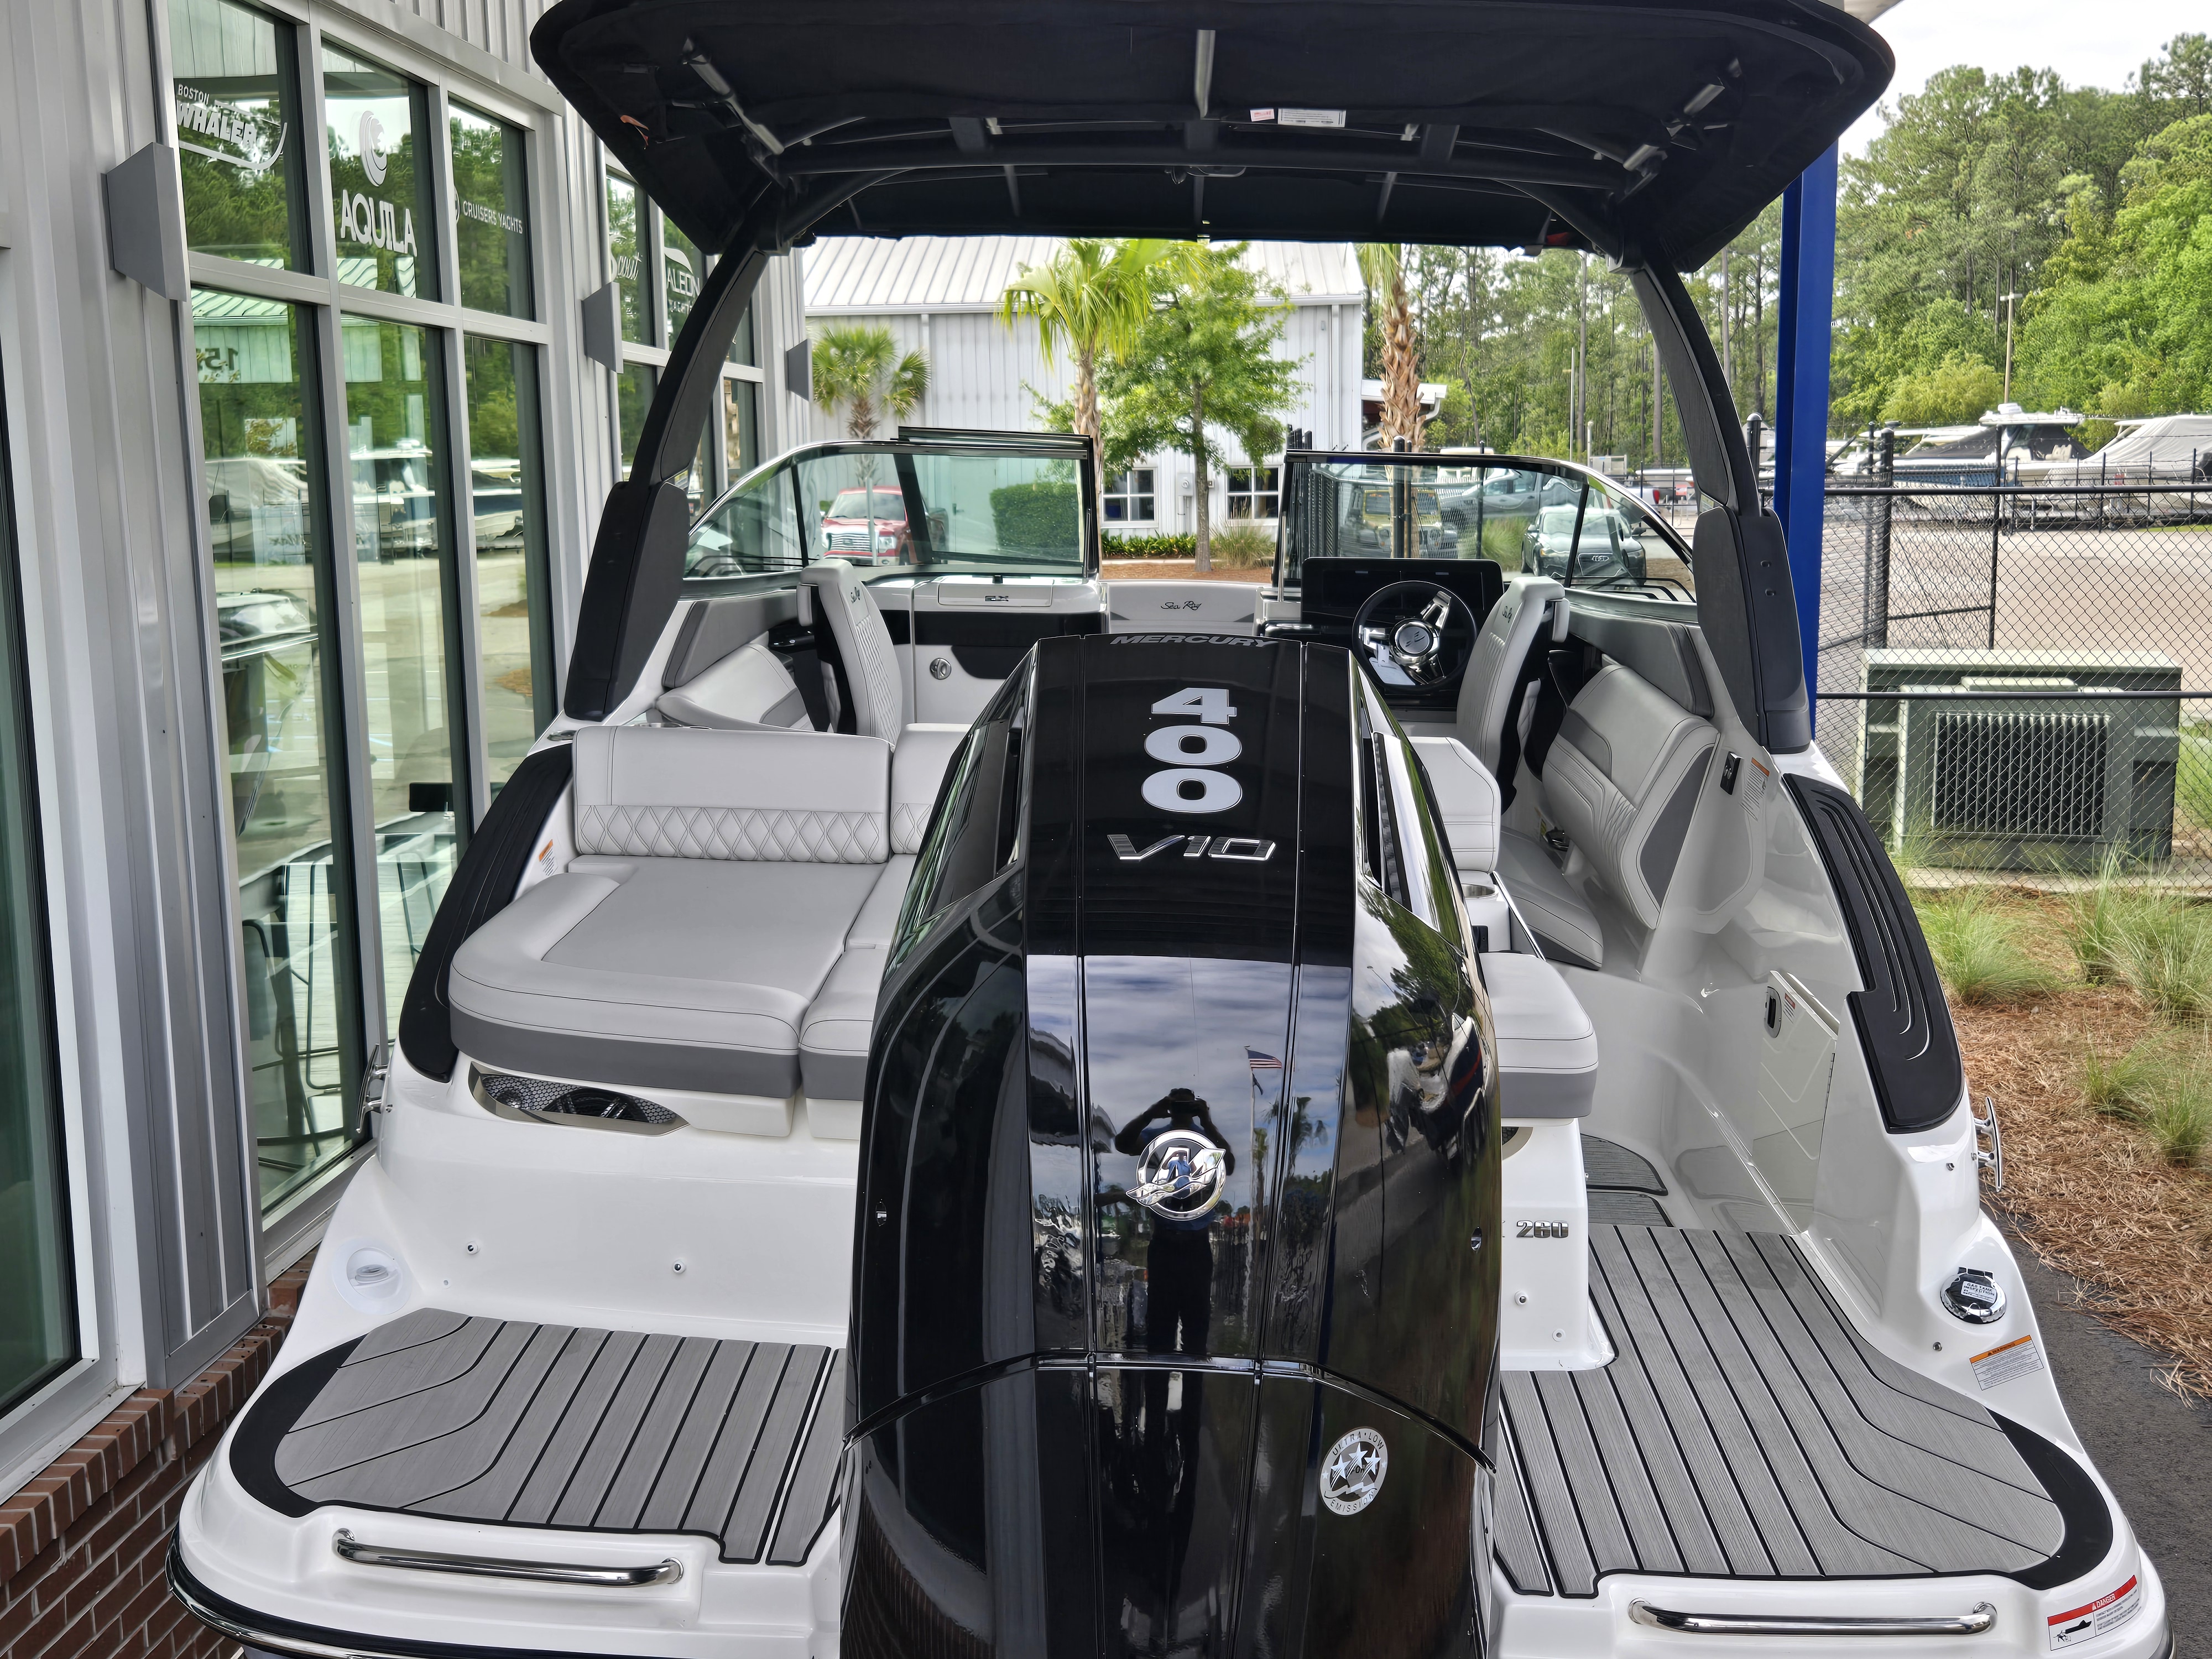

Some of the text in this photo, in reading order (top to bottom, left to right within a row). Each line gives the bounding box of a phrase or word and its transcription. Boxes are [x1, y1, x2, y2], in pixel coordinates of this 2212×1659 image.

[178, 84, 210, 105] BOSTON
[176, 100, 258, 149] WHALER
[340, 189, 418, 257] AQUILA
[463, 200, 523, 234] CRUISERS YACHTS
[667, 267, 701, 298] ALEON
[1182, 601, 1202, 611] Ray
[1109, 635, 1278, 648] MERCURY
[1141, 687, 1243, 814] 400
[1107, 834, 1277, 861] V10
[1516, 1220, 1569, 1239] 260
[1332, 1431, 1384, 1455] ULTRA LOW
[1330, 1490, 1374, 1512] EMISSION
